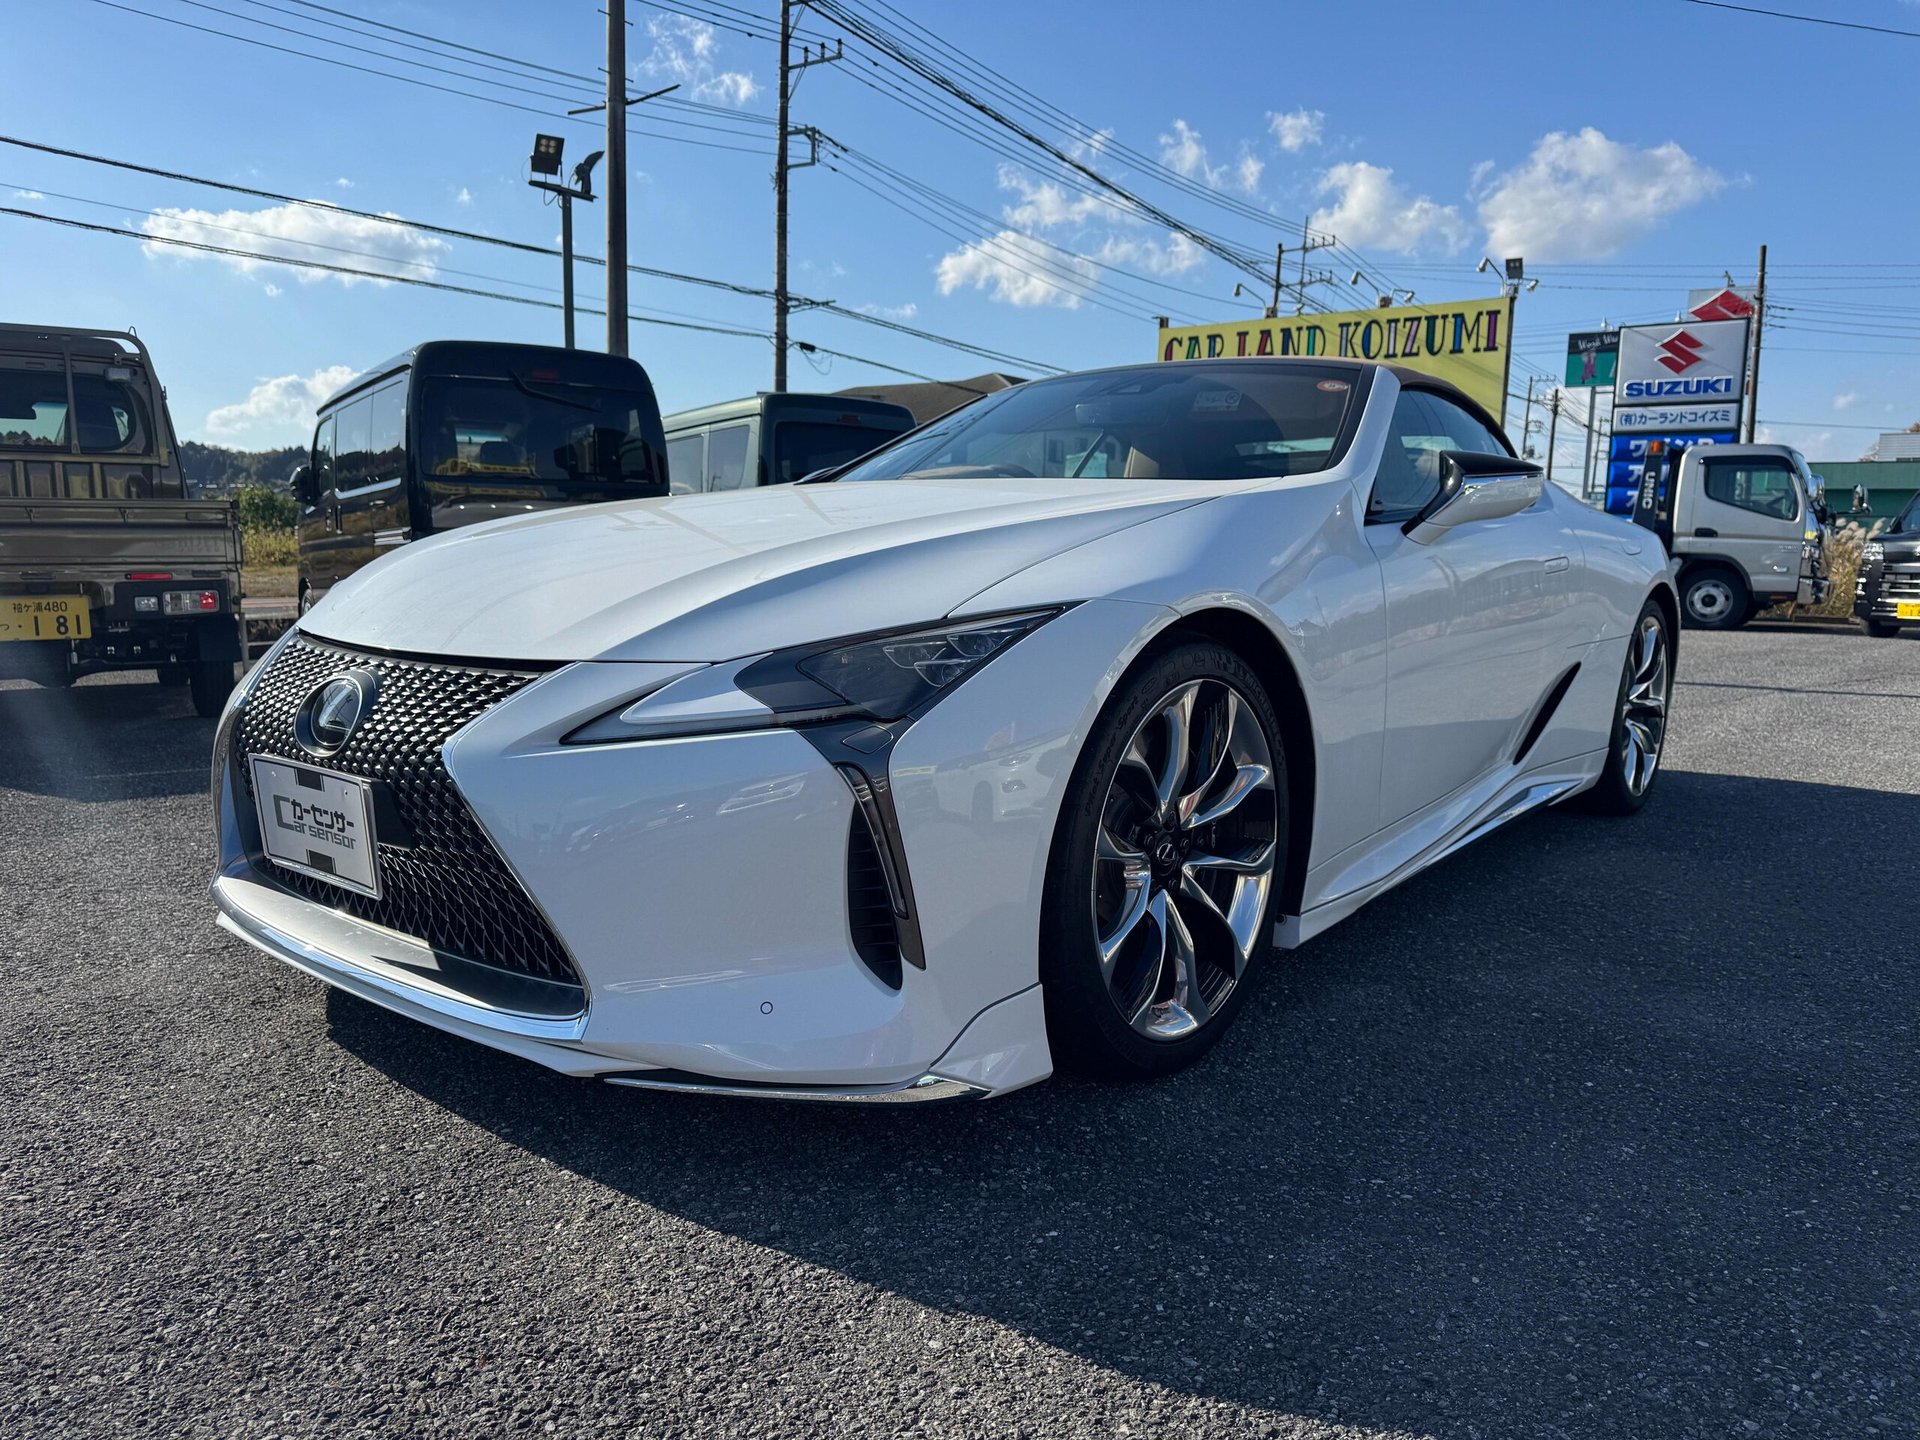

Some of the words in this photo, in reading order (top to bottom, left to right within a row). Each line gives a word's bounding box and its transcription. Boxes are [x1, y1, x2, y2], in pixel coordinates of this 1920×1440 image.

[1236, 325, 1326, 357] LAND
[1338, 310, 1502, 359] KOIZUMI
[1624, 376, 1734, 398] SUZUKI
[1619, 410, 1731, 428] (有)カーランドコイズミ
[1642, 471, 1656, 510] UNIC
[1117, 694, 1139, 732] Sport
[291, 799, 355, 834] カーセンサー
